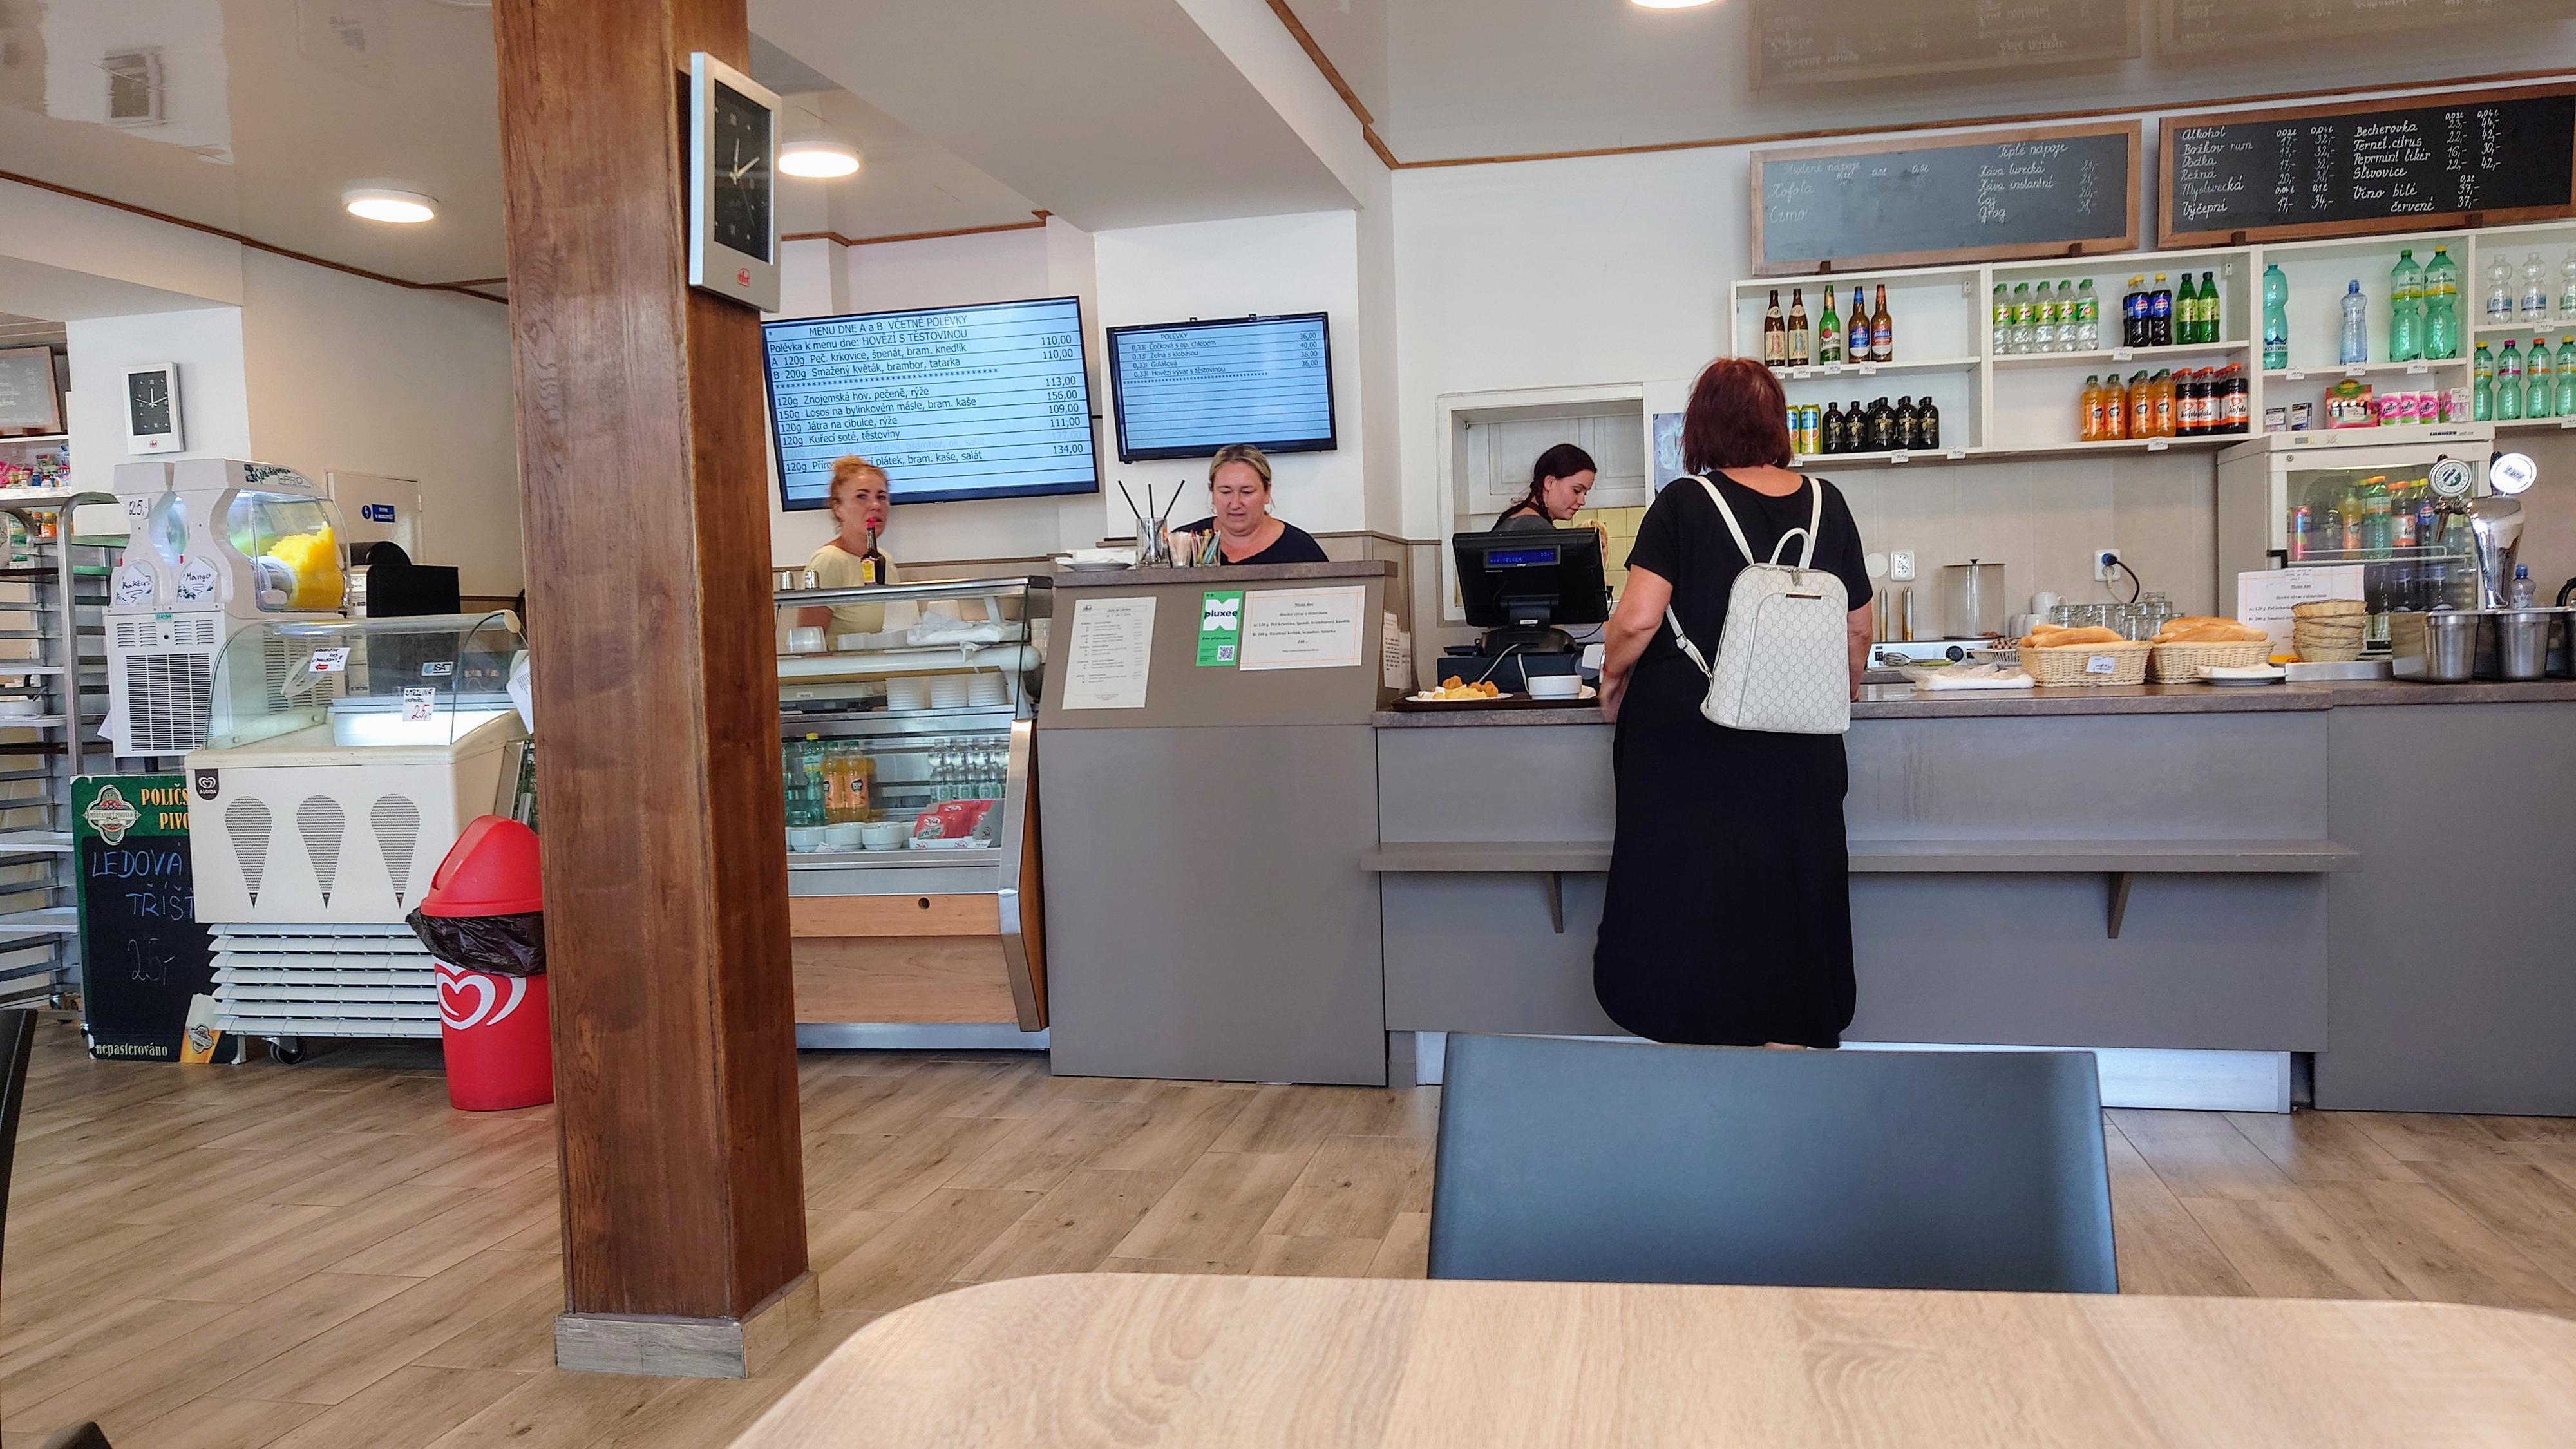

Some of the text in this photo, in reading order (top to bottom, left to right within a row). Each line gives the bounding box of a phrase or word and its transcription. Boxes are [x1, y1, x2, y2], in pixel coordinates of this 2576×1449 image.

[2181, 126, 2226, 140] Alkohol
[2354, 118, 2500, 137] Becherovka 23,- 44,-
[2447, 131, 2468, 143] 22,-
[2481, 129, 2501, 142] 42,-
[1998, 142, 2069, 160] Teplé nápoje
[2183, 135, 2335, 156] Božkov rum 17,- 32,-
[2353, 142, 2501, 167] Peprmint likér 16,- 30,-
[2182, 146, 2335, 167] Vodka 17,- 32,-
[2280, 159, 2296, 171] 17,-
[2314, 159, 2334, 171] 32,-
[1978, 164, 2004, 177] Káva
[2009, 160, 2045, 175] turecká
[2353, 158, 2501, 180] Slivovice 22,- 42,-
[1772, 180, 1814, 204] Kofola
[1978, 178, 2005, 192] Káva
[2010, 175, 2054, 189] instantní
[2182, 175, 2244, 201] Myslivecká
[2278, 174, 2295, 185] 20,-
[2458, 184, 2480, 195] 37,-
[2183, 194, 2334, 221] Výčepní 17,- 34,-
[2391, 196, 2479, 212] červené 37,-
[1978, 206, 2006, 224] Grog
[810, 326, 835, 336] MENU
[838, 325, 857, 334] DNE
[860, 323, 866, 332] A
[877, 322, 883, 330] B
[888, 316, 924, 330] VČETNĚ
[927, 314, 967, 328] POLÉVKY
[770, 343, 802, 353] Polévka
[805, 342, 810, 350] k
[840, 338, 859, 348] dne:
[862, 332, 896, 346] HOVĚZÍ
[899, 334, 905, 343] S
[908, 329, 967, 343] TĚSTOVINOU
[784, 356, 805, 367] 120g
[810, 354, 828, 363] Peč.
[831, 351, 869, 362] krkovice,
[871, 348, 904, 359] špenát,
[907, 346, 933, 355] bram.
[935, 343, 967, 354] knedlík
[1041, 335, 1072, 346] 110,00
[773, 348, 1074, 381] B 200g Smažený květák, brambor, tatarka 110,00
[777, 376, 1076, 408] 120g Znojemská hov. pečeně, rýže 113,00
[779, 390, 1077, 420] 150g Losos na bylinkovém másle, bram. kaše 156,00
[781, 424, 802, 433] 120g
[807, 421, 828, 431] Játra
[844, 417, 876, 427] cibulce,
[879, 415, 898, 426] rýže
[1048, 403, 1079, 415] 109,00
[782, 417, 1081, 446] 120g Kuřecí soté, těstoviny 111,00
[786, 462, 806, 471] 120g
[876, 455, 905, 466] plátek,
[908, 453, 933, 464] bram.
[936, 453, 958, 462] kaše,
[961, 450, 982, 460] salát
[1053, 444, 1083, 456] 134,00
[186, 573, 211, 582] Mango
[1204, 610, 1238, 619] pluxee
[141, 782, 189, 806] POLIČS
[95, 1042, 168, 1057] nepasterováno
